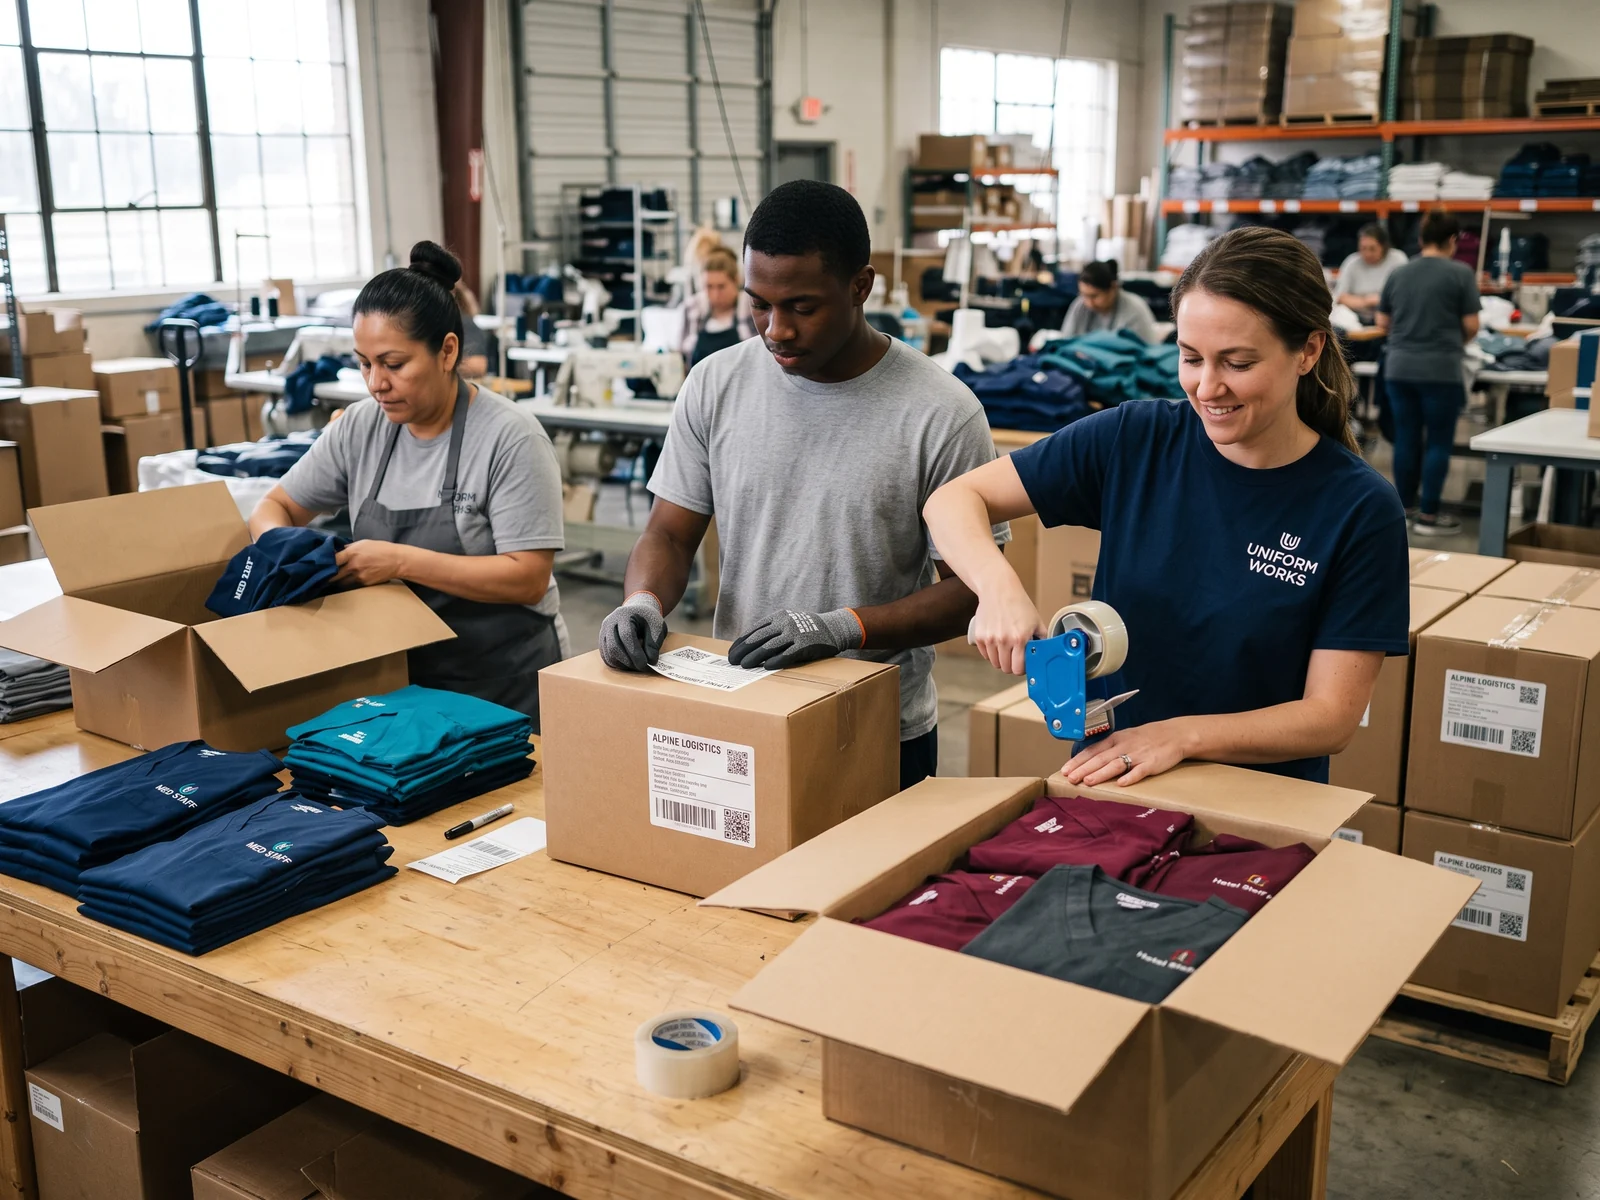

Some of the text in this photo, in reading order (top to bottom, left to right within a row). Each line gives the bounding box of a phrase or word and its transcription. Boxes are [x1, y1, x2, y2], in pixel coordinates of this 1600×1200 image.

[1247, 542, 1318, 575] UNIFORM
[1249, 558, 1306, 587] WORKS
[1451, 674, 1516, 690] ALPINE LOGISTICS
[652, 733, 721, 755] ALPINE LOGISTICS
[172, 793, 198, 808] STAFF
[1439, 856, 1464, 867] ALPINE
[1465, 861, 1503, 876] LOGISTICS
